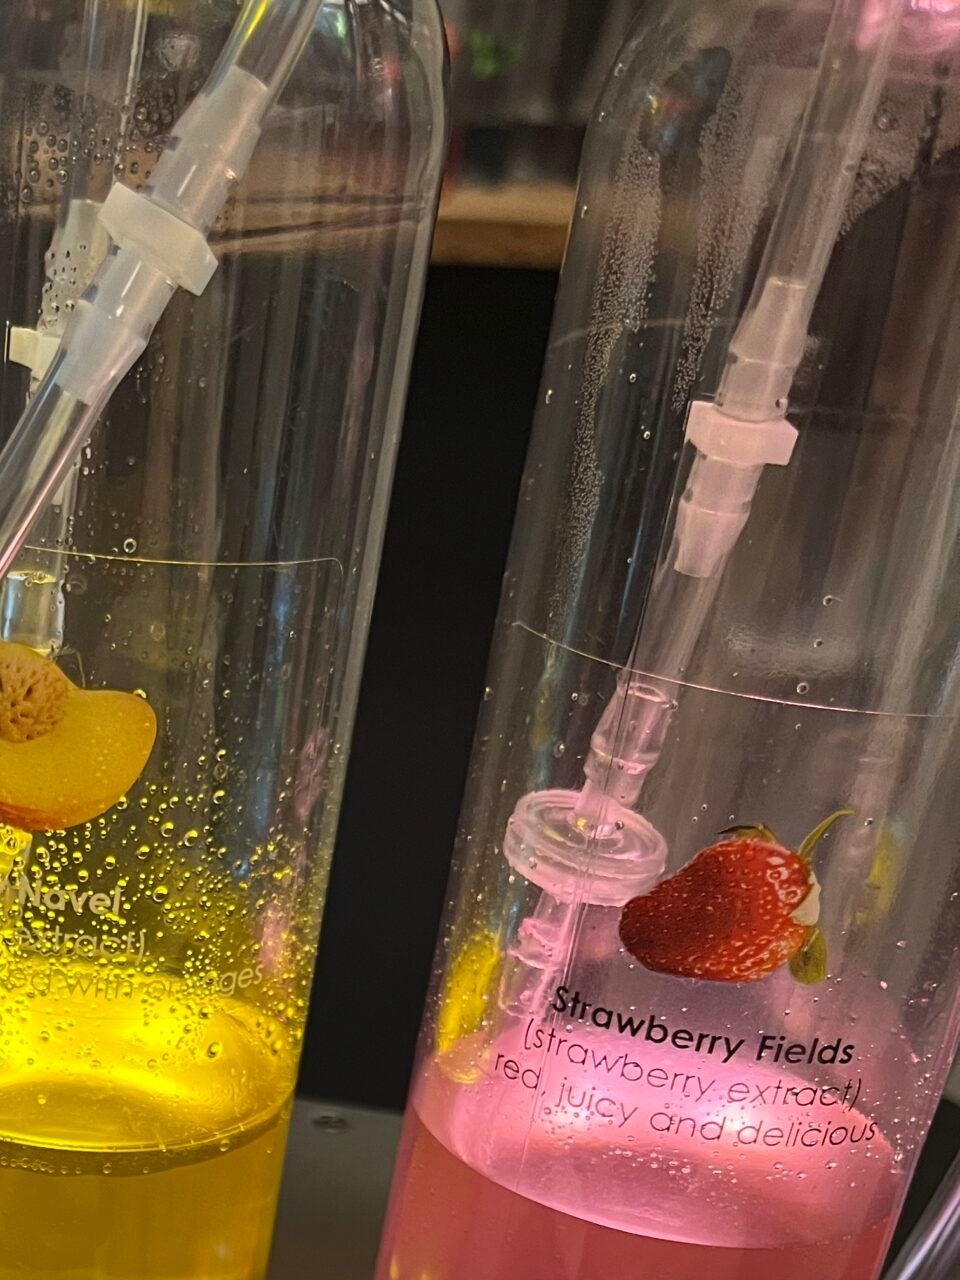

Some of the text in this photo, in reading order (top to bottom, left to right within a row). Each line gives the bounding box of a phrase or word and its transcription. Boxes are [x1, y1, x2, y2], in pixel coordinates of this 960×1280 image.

[17, 870, 122, 916] Navel
[524, 1018, 863, 1111] (strawberry extract)
[551, 985, 855, 1065] Strawberry Fields
[493, 1051, 878, 1148] red, juicy and delicious
